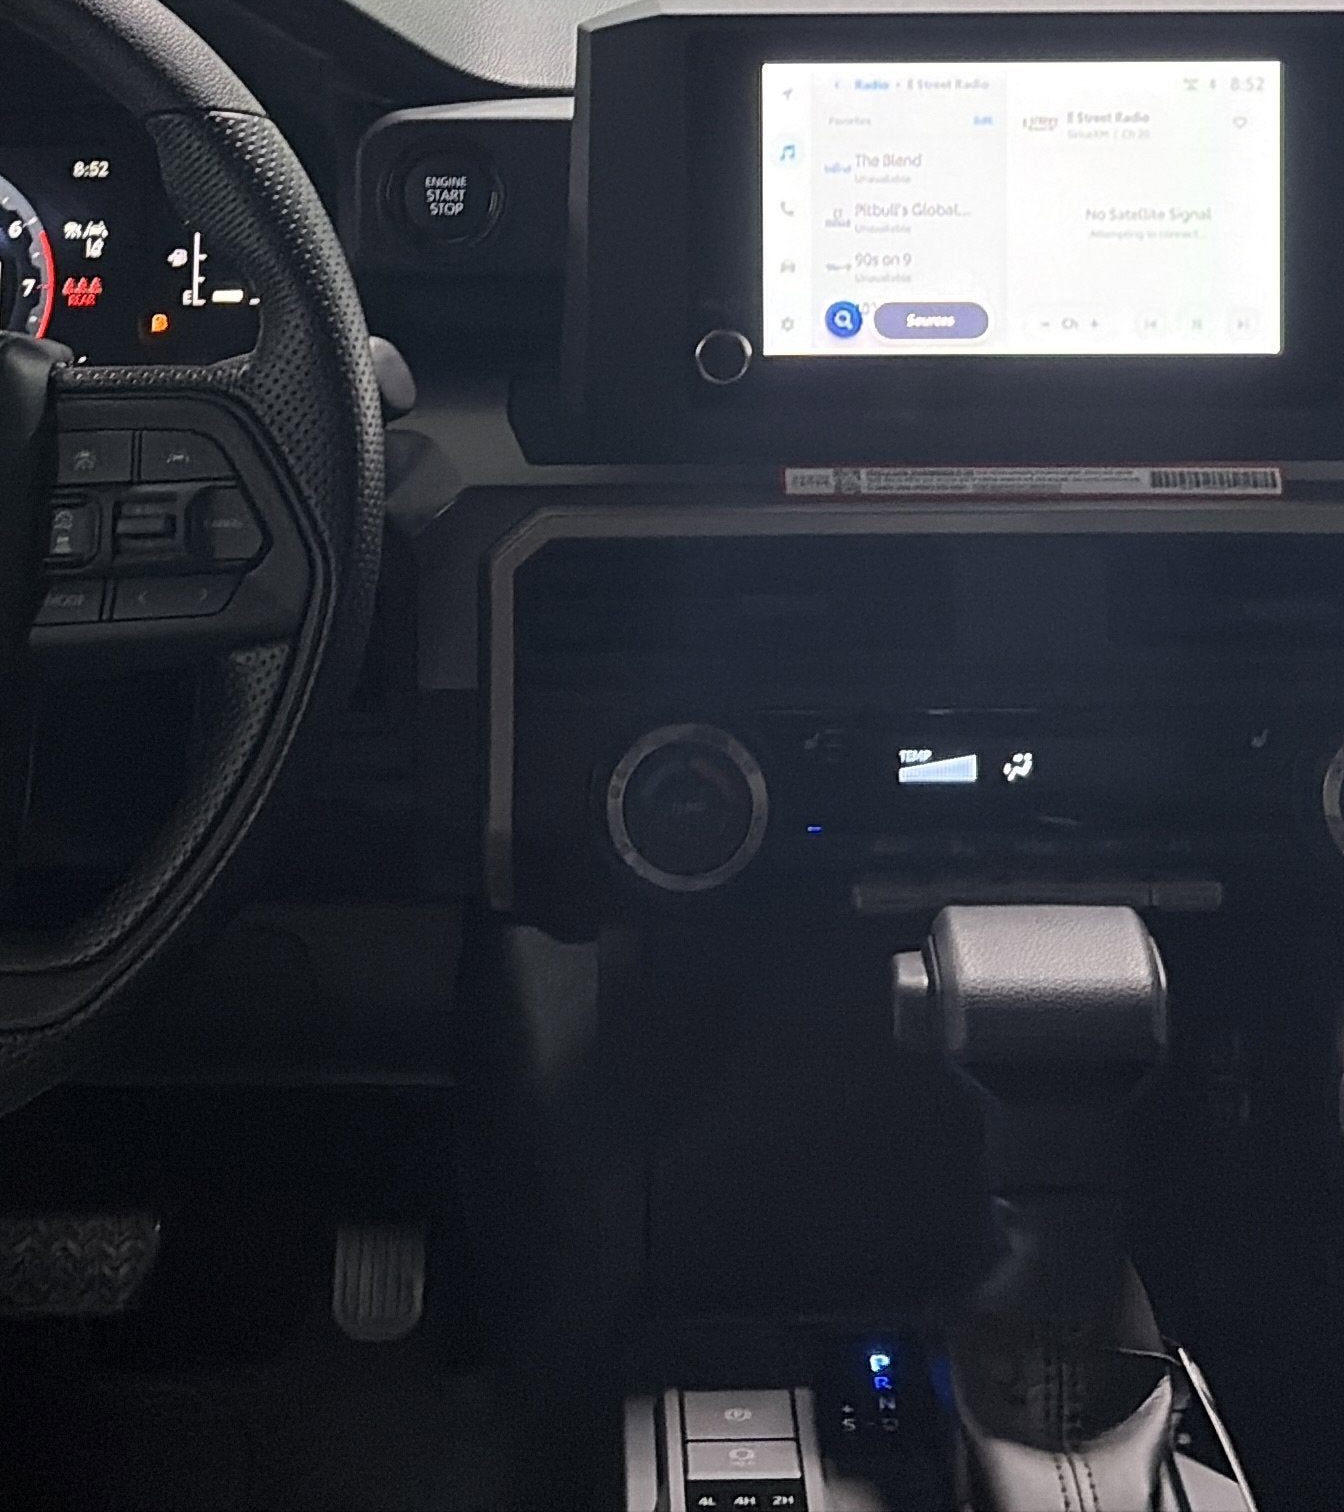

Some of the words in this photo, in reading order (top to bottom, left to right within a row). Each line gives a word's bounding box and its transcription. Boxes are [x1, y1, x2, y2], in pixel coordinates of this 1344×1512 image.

[855, 78, 889, 90] Radio
[917, 78, 952, 89] Street
[955, 78, 989, 89] Radio
[1230, 76, 1265, 93] 8:52
[1076, 110, 1112, 124] Street
[1114, 110, 1150, 124] Radio
[855, 153, 880, 168] The
[882, 152, 923, 168] Blend
[72, 160, 110, 178] 8:52
[425, 176, 467, 188] ENGINE
[426, 189, 466, 203] START
[429, 202, 464, 216] STOP
[855, 202, 909, 217] Pitbull's
[1085, 208, 1106, 221] No
[1109, 207, 1165, 221] Satellite
[1168, 207, 1212, 224] Signal
[8, 220, 23, 238] 6
[854, 252, 879, 267] 90s
[882, 255, 900, 266] on
[902, 252, 913, 266] 9
[22, 279, 36, 297] 7
[67, 294, 97, 307] REAR
[182, 290, 194, 306] E
[905, 313, 955, 328] Sources
[1061, 318, 1079, 331] Ch
[899, 749, 932, 763] TEMP
[869, 1354, 891, 1372] P
[874, 1376, 892, 1389] R
[879, 1397, 896, 1409] N
[841, 1418, 856, 1432] S
[698, 1496, 716, 1506] 4L
[734, 1496, 756, 1506] 4H
[772, 1495, 795, 1506] 2H
